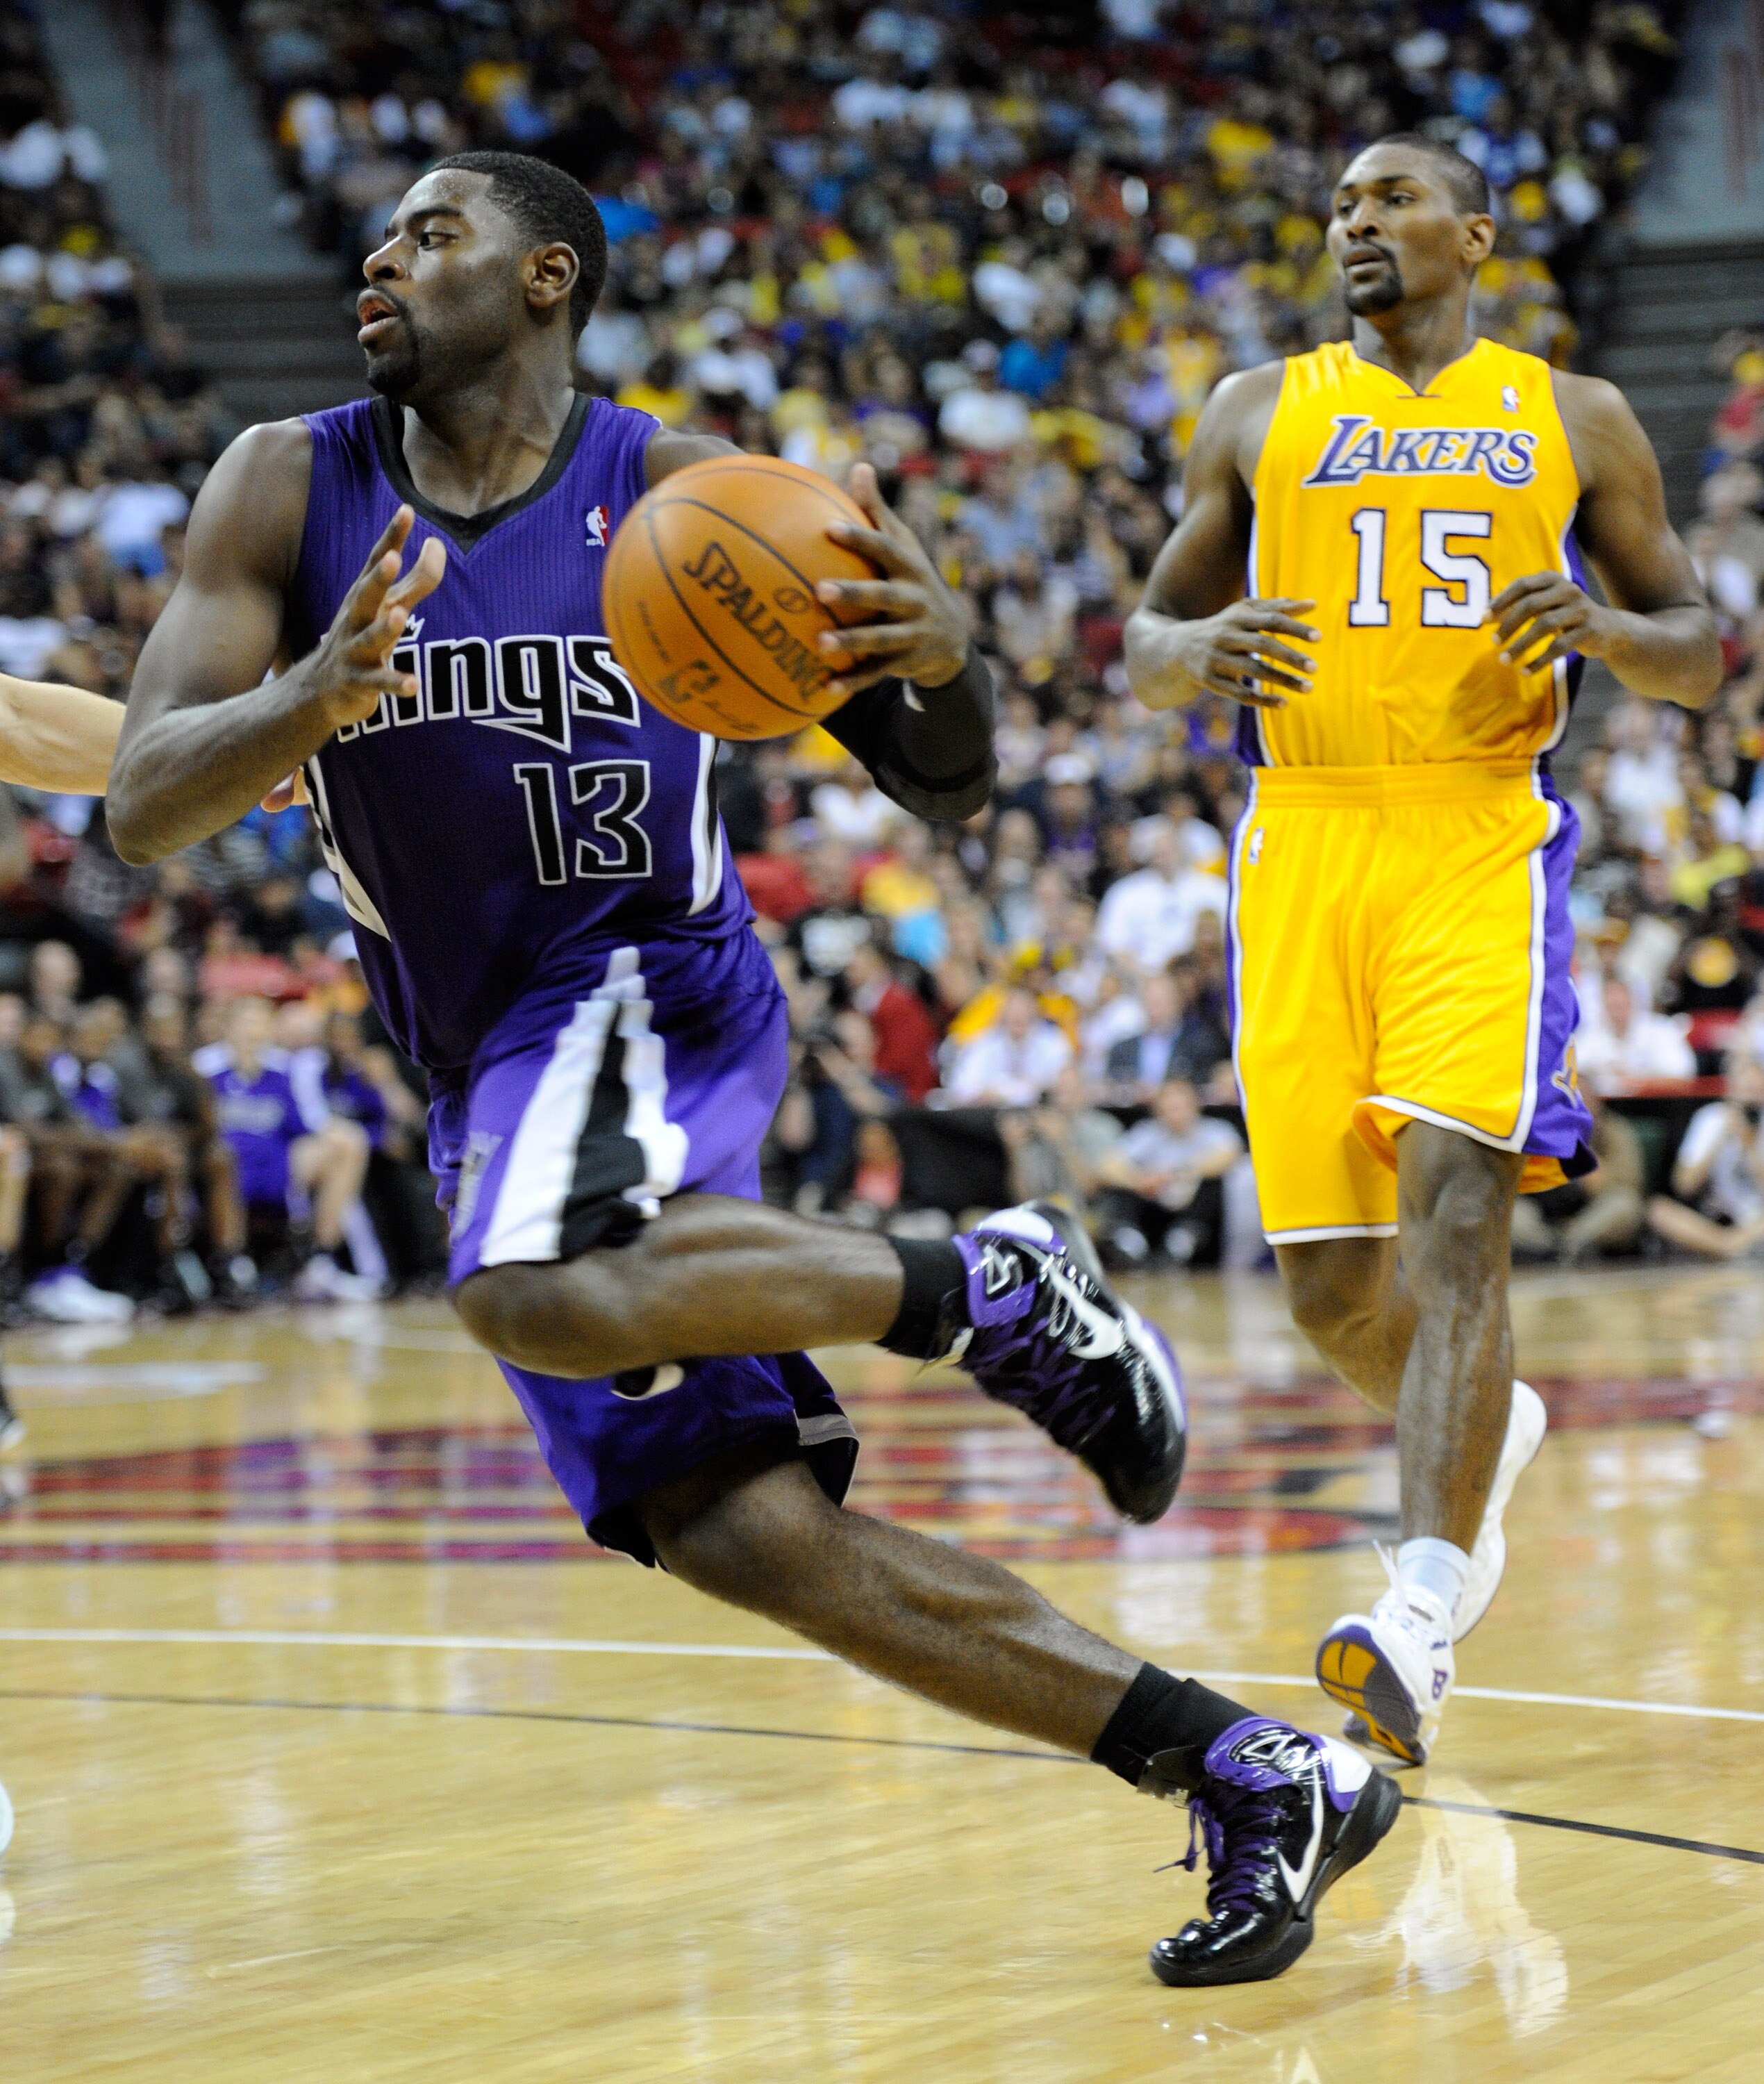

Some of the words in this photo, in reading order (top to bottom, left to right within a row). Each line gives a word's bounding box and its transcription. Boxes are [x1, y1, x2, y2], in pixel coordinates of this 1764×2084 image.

[1301, 415, 1538, 488] LAKERS
[682, 540, 833, 704] SPALDING
[1349, 507, 1492, 628] 15
[333, 618, 641, 754] ings
[514, 760, 652, 886] 13
